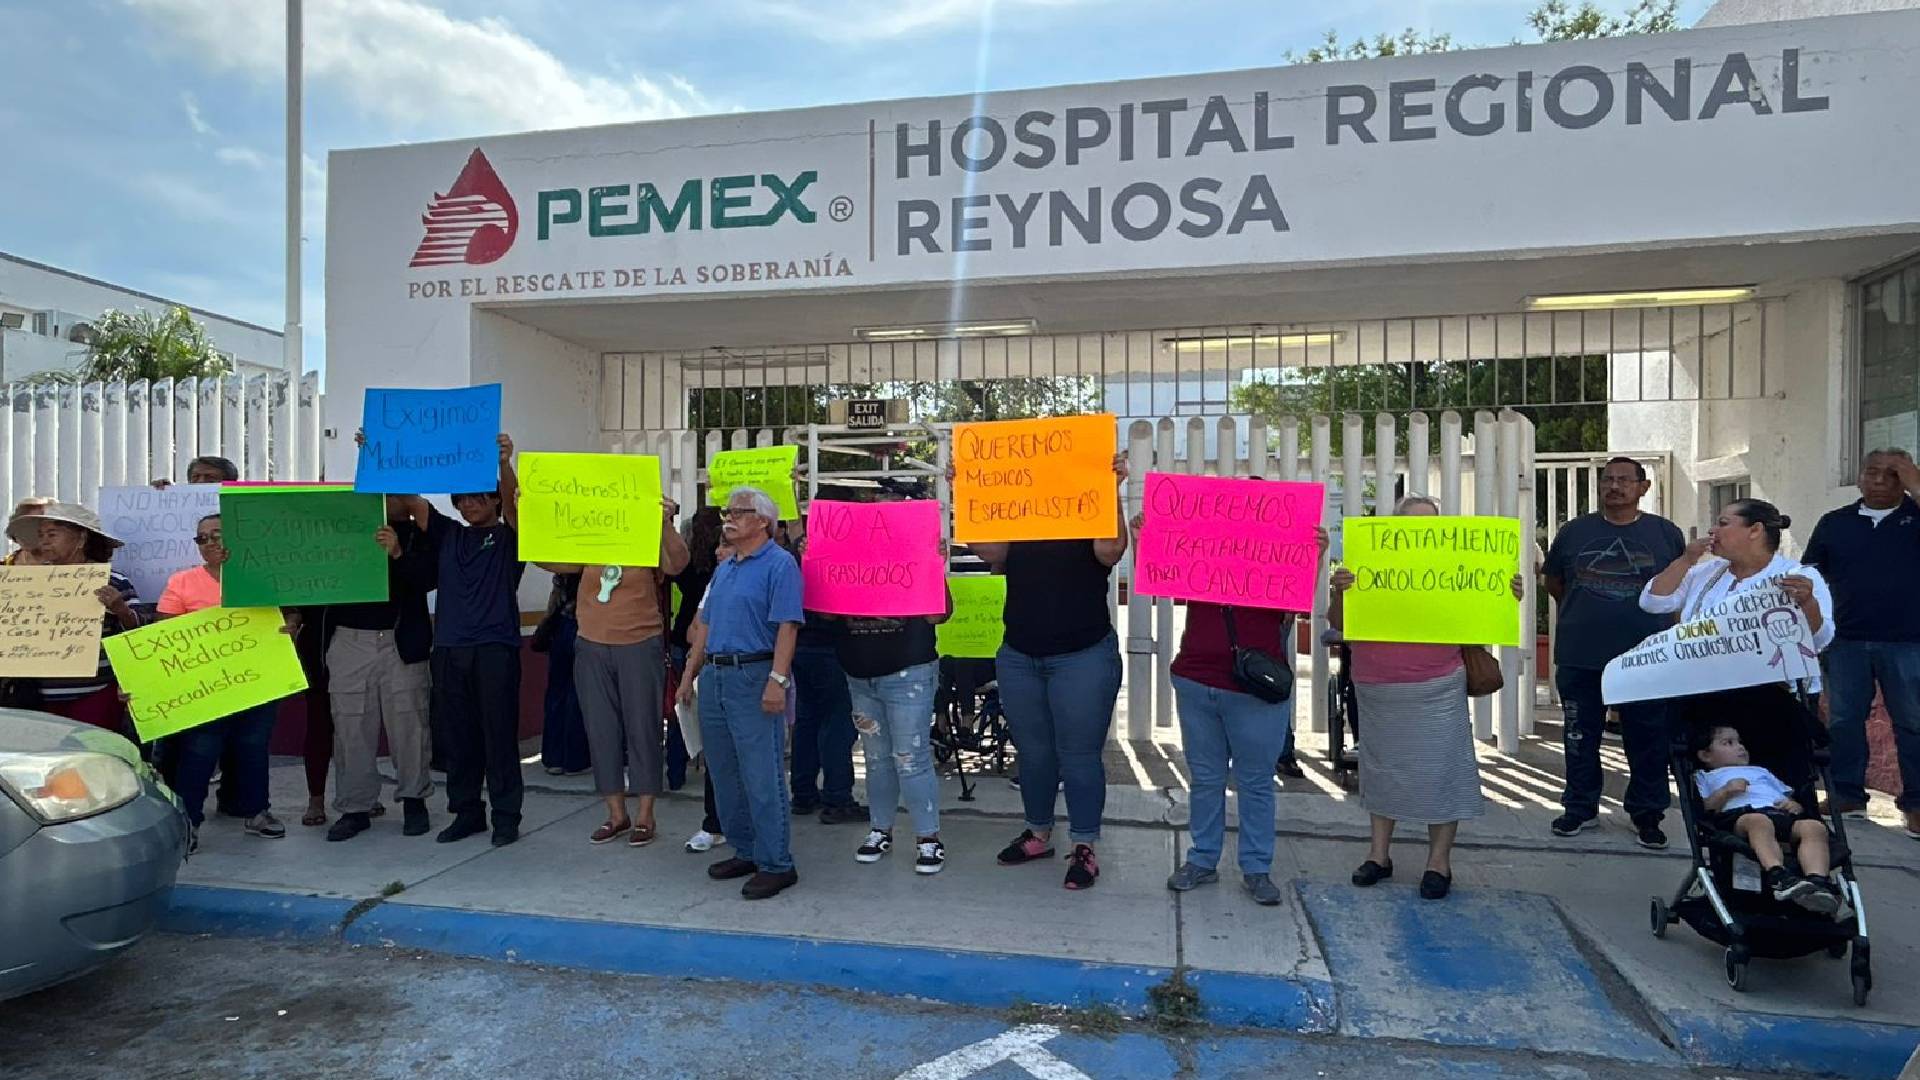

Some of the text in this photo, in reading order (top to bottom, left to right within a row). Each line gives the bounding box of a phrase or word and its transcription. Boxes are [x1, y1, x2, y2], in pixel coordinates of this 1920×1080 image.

[897, 48, 1830, 178] HOSPITAL REGIONAL
[537, 170, 818, 241] PEMEX
[897, 174, 1290, 256] REYNOSA
[408, 251, 854, 299] POR EL RESCATE DE LA SOBERANÍA
[382, 391, 493, 434] Exigimos
[848, 415, 884, 426] SALIDA
[854, 403, 878, 414] EXIT
[958, 427, 1073, 462] QUEREMOS
[965, 467, 1033, 488] MEDICOS
[968, 490, 1101, 525] ESPECIALISTAS
[1151, 476, 1297, 529] QUEREMOS
[814, 504, 893, 542] NO A
[1158, 528, 1315, 569] TRATAMIENTOS
[1187, 560, 1298, 600] CANCER
[122, 611, 251, 661] Exigimos
[1676, 619, 1719, 641] DIGNA
